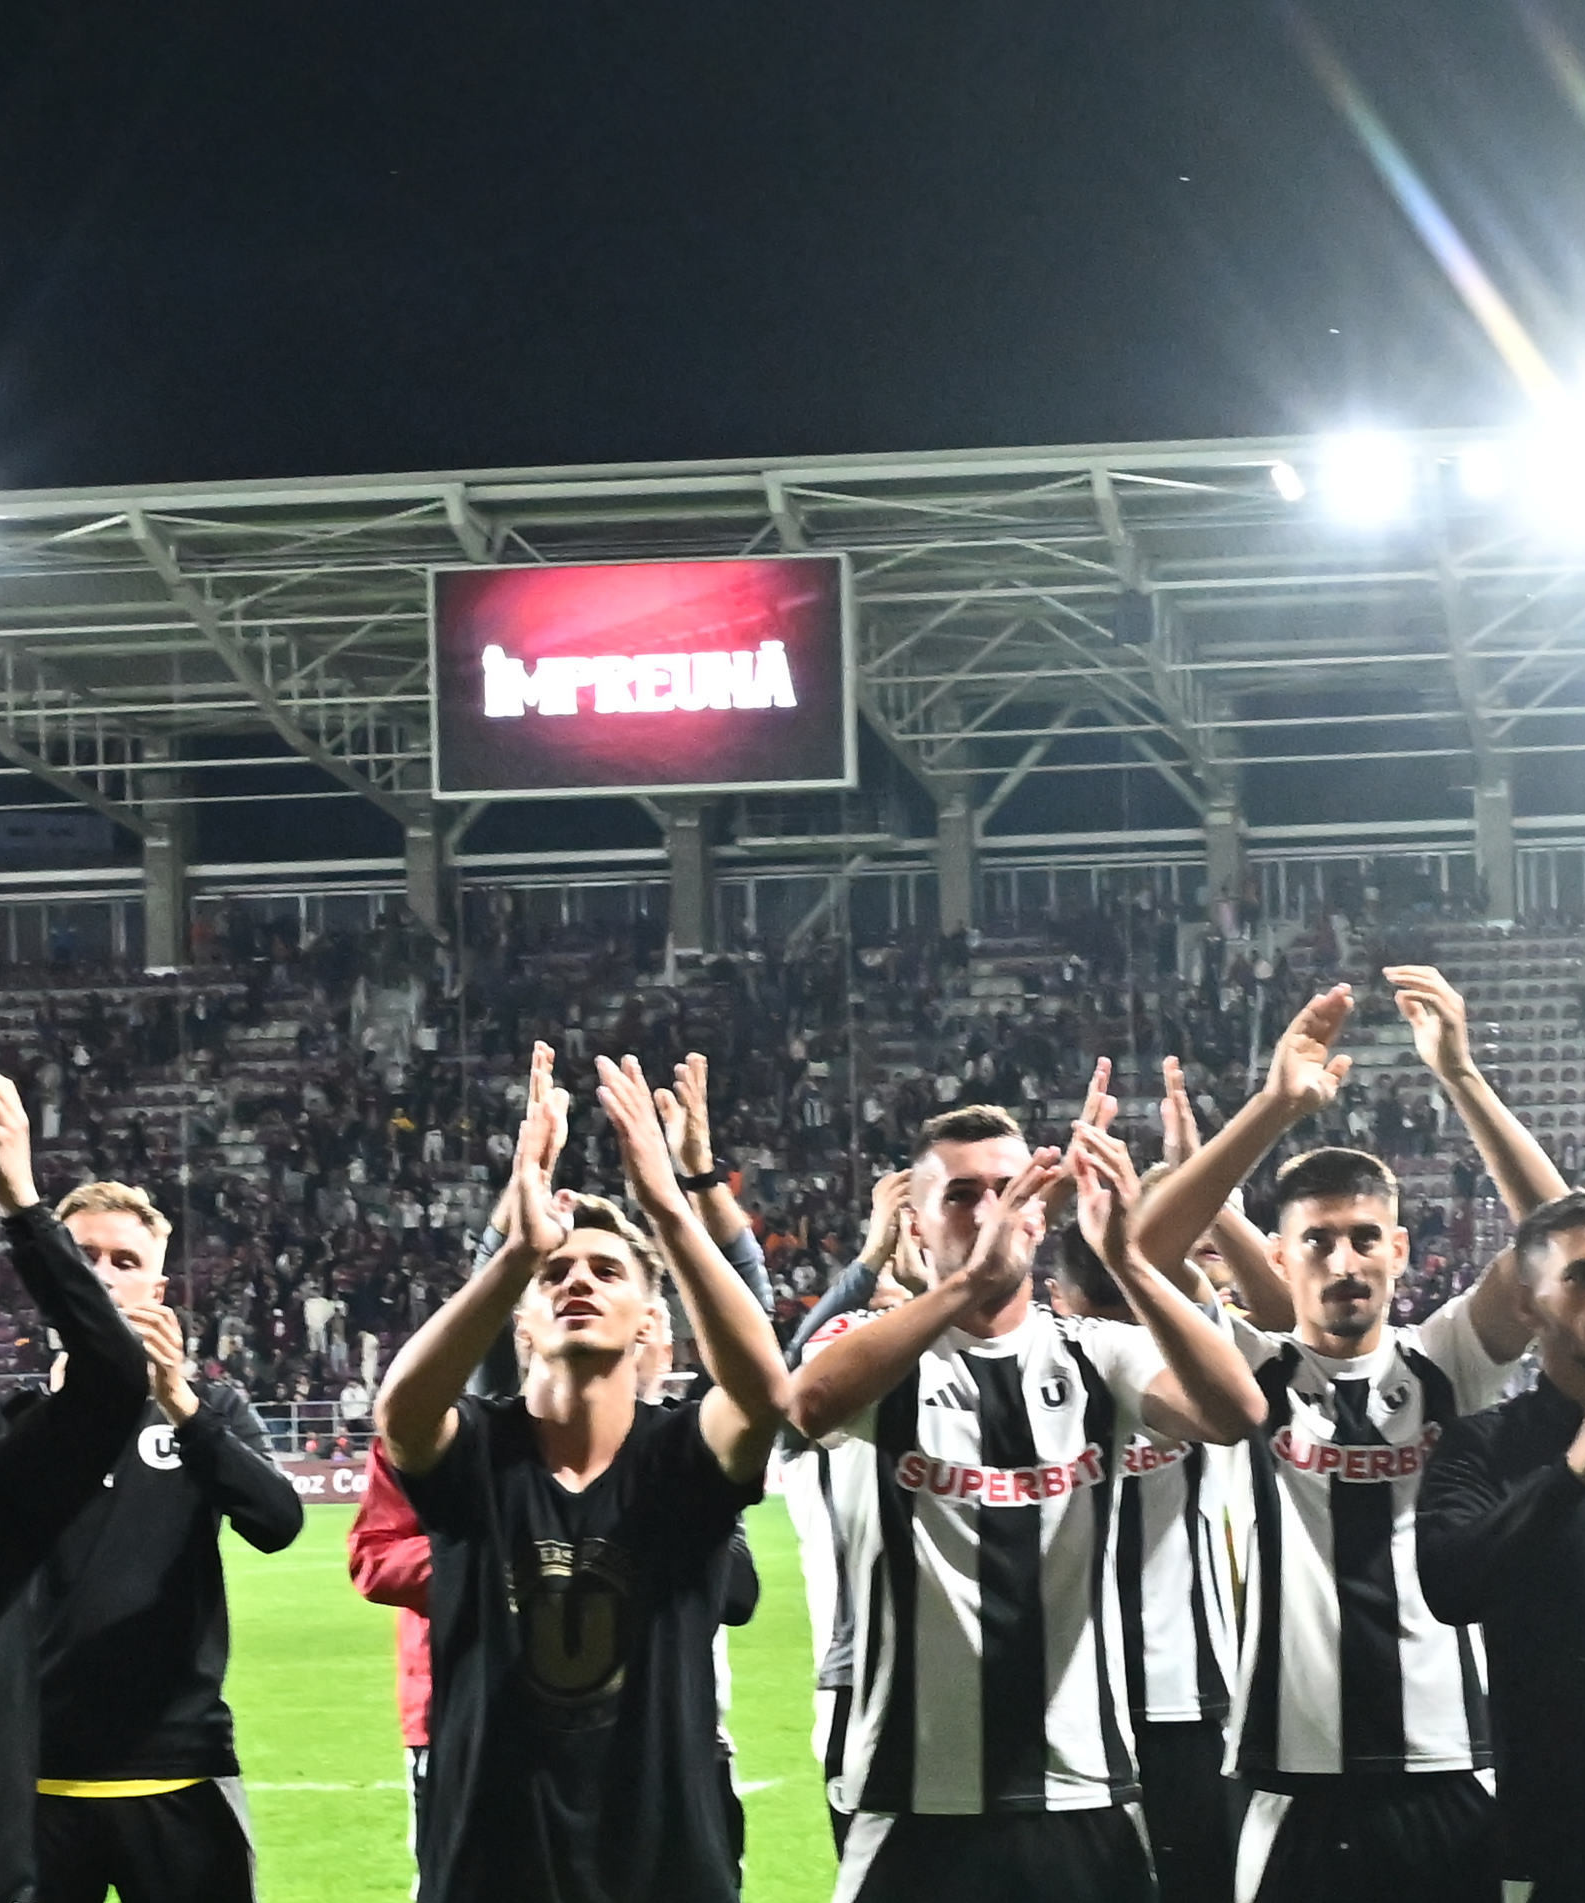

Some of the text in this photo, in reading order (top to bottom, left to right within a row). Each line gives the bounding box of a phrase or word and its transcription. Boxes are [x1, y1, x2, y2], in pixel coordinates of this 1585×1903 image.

[481, 640, 798, 718] ÎMPREUNĂ
[1041, 1381, 1066, 1407] U
[900, 1447, 1101, 1503] SUPERBET
